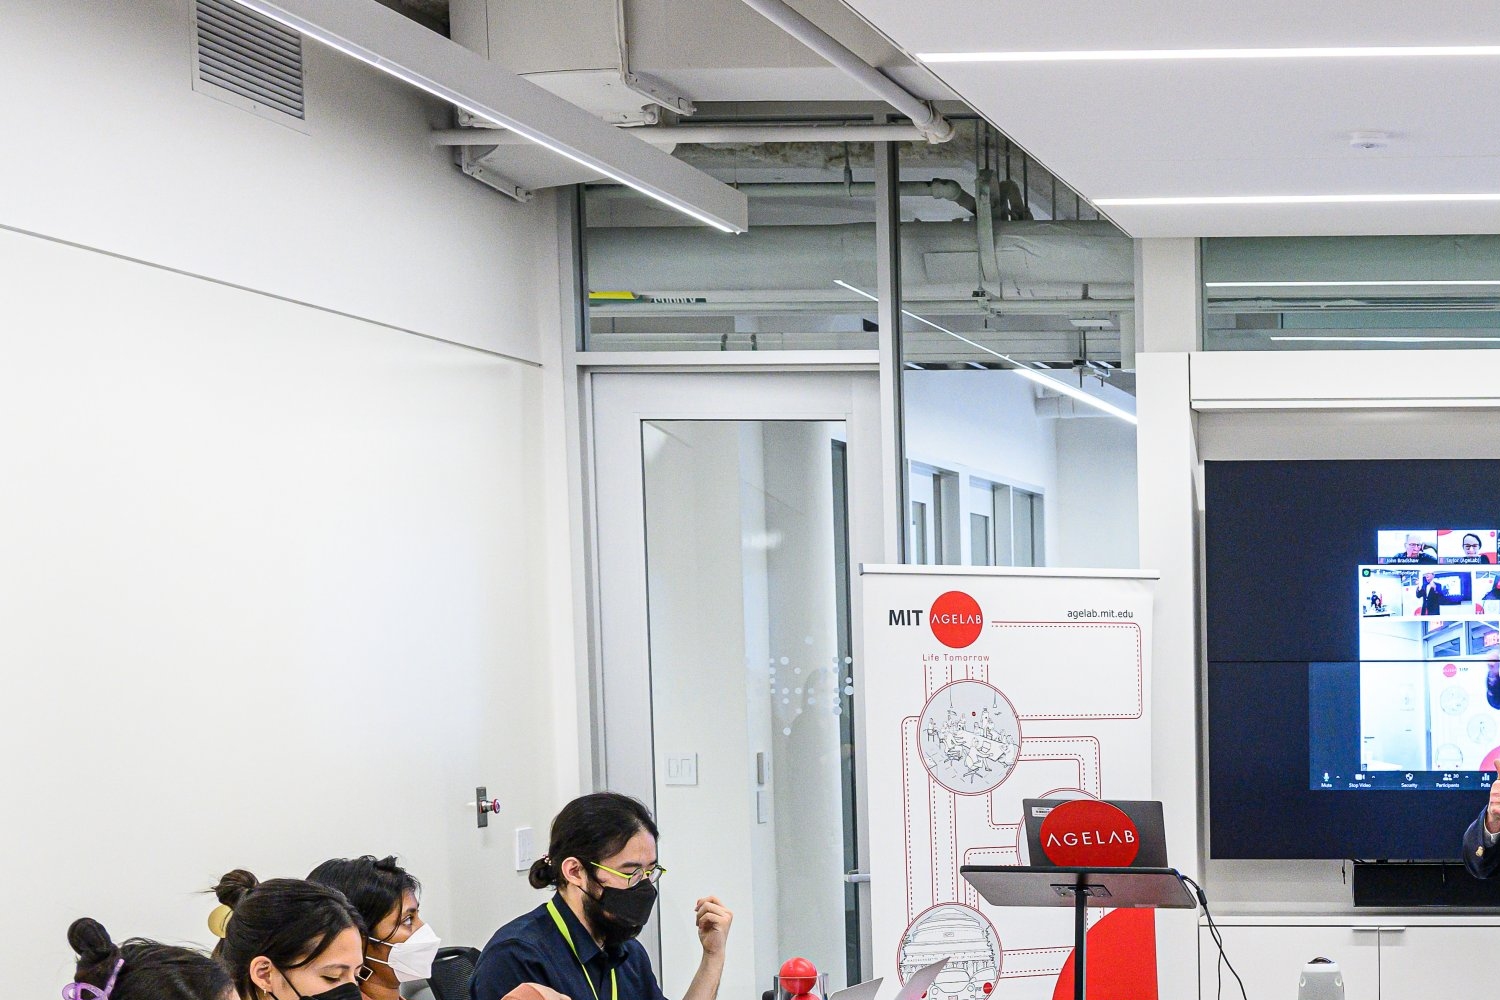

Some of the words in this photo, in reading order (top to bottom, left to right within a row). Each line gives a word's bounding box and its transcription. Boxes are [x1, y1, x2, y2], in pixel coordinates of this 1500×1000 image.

[888, 609, 923, 627] MIT
[931, 612, 983, 625] AGELAB
[1067, 609, 1134, 620] agelab.mit.edu
[922, 653, 940, 662] Life
[943, 653, 990, 662] Tomorrow
[1046, 830, 1135, 848] AGELAB
